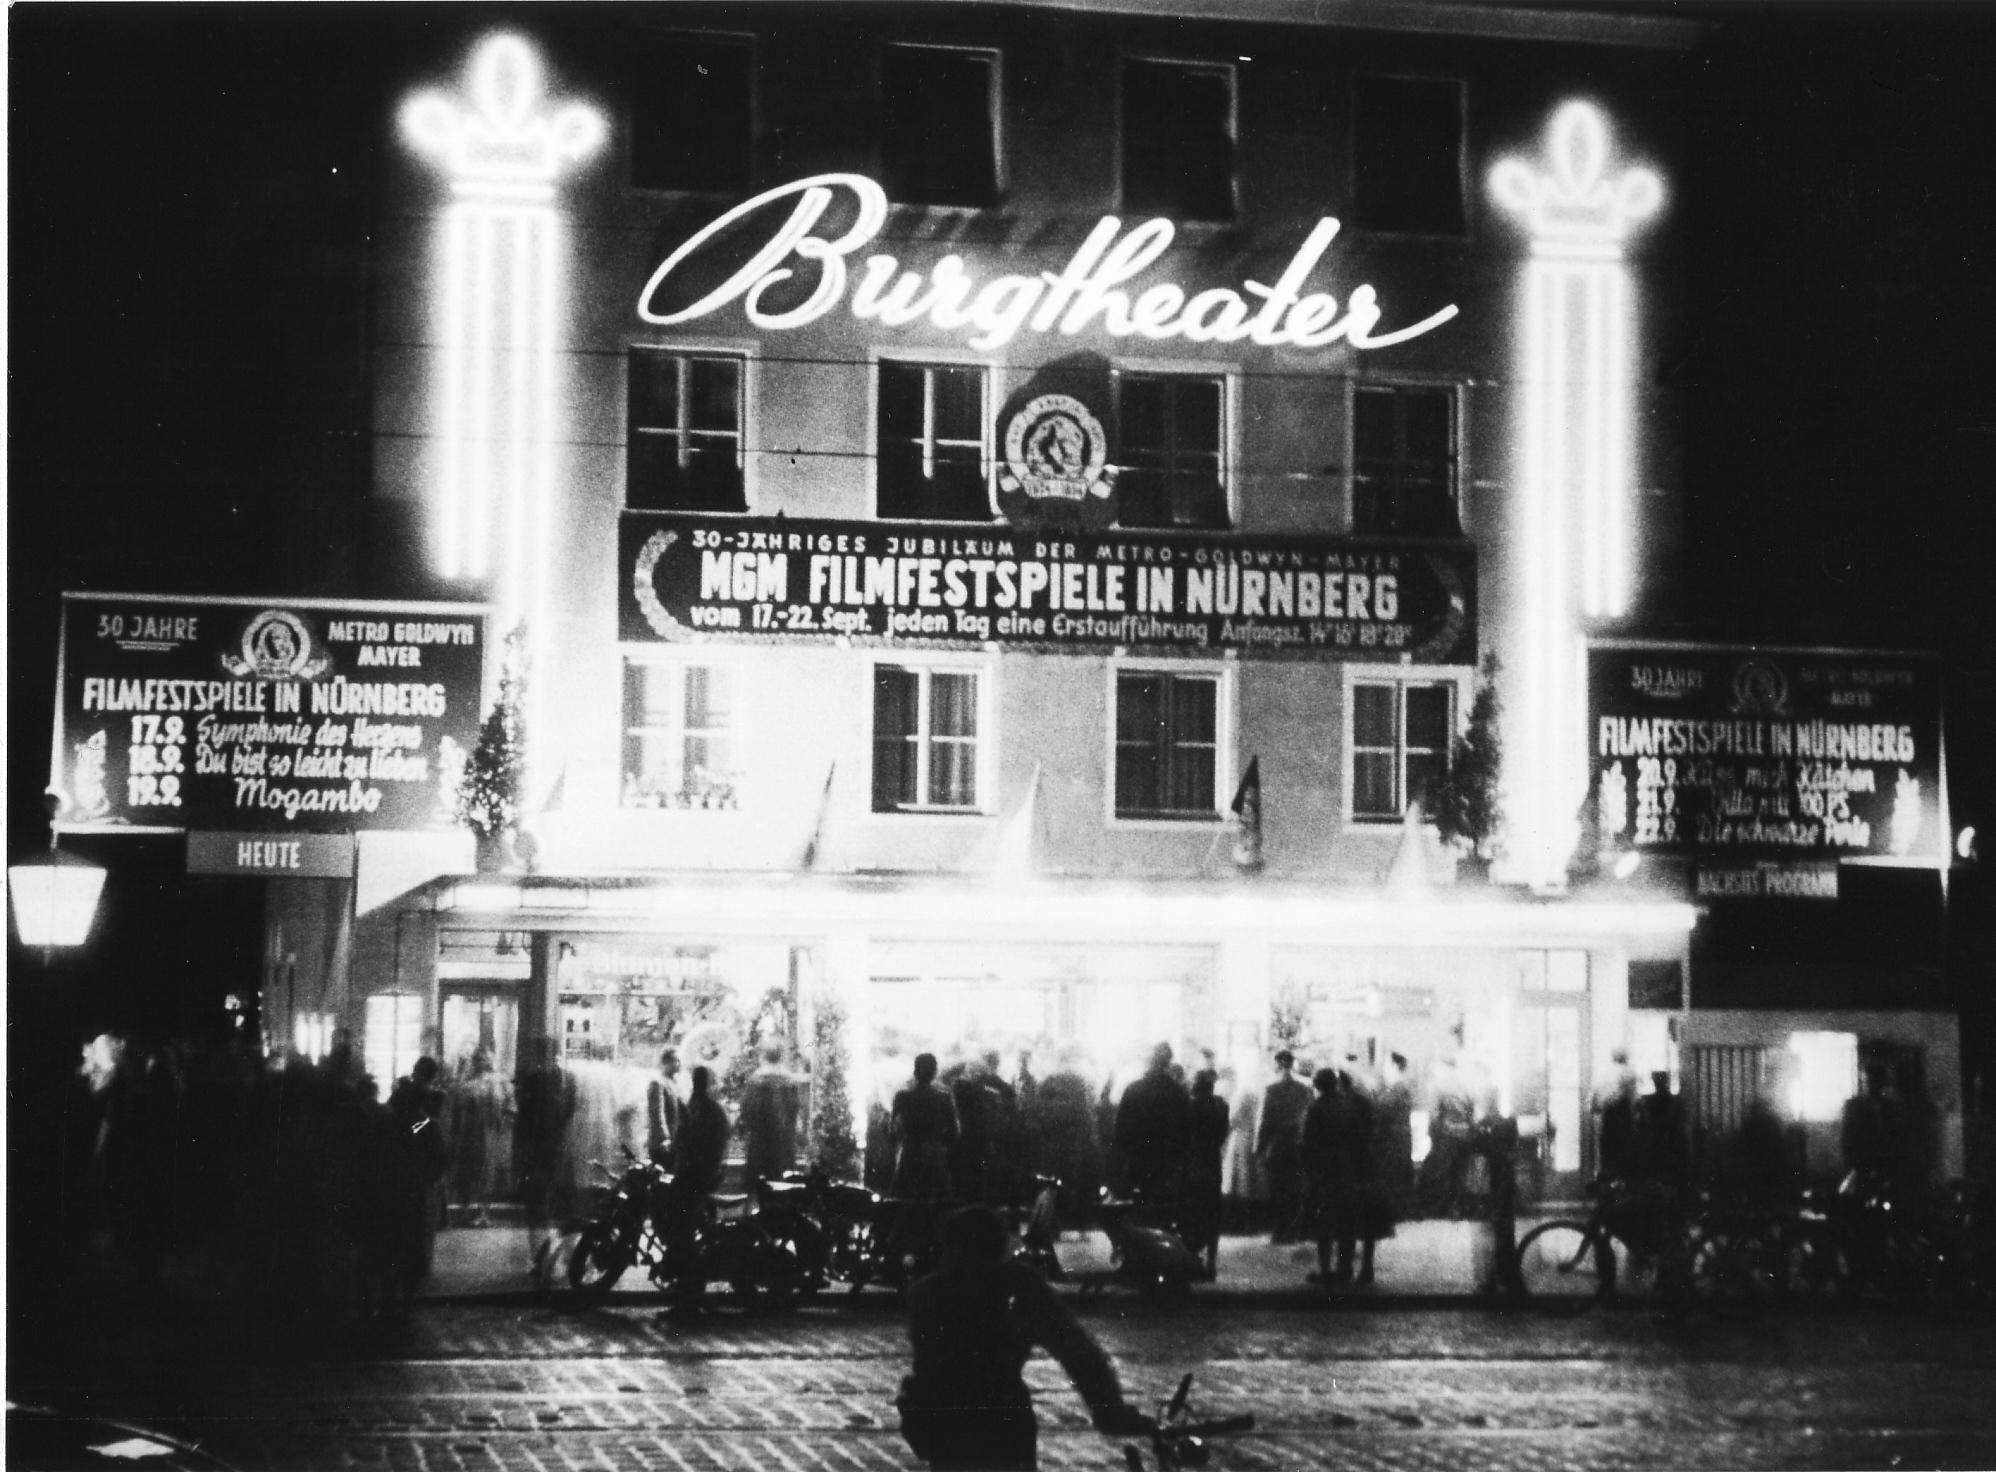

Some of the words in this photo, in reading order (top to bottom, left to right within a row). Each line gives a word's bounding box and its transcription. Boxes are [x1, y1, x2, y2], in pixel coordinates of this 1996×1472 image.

[637, 172, 1459, 350] Burgtheater
[692, 529, 866, 551] 30-JÄHRIGES
[887, 536, 1015, 557] JUBILÄUM
[1035, 541, 1076, 559] DER
[700, 549, 788, 603] MGM
[808, 554, 1126, 612] FILMFESTSPIELE
[1136, 565, 1174, 614] IN
[1186, 557, 1398, 620] NÜRNBERG
[97, 615, 122, 638] 30
[130, 616, 198, 641] JAHRE
[328, 621, 390, 642] METRO
[394, 622, 474, 645] GOLDWYN
[690, 605, 741, 628] vom
[821, 605, 872, 636] Sept.
[883, 605, 949, 638] jeden
[953, 608, 990, 639] Tag
[996, 610, 1047, 635] eine
[1052, 612, 1209, 648] Erstaufführung
[357, 645, 422, 667] MAYER
[83, 677, 267, 713] FILMFESTSPIELE
[274, 681, 300, 714] IN
[312, 674, 446, 717] NÜRNBERG
[131, 714, 187, 745] 17.9.
[197, 713, 312, 750] Symphonie
[315, 717, 347, 747] des
[1600, 715, 1763, 756] FILMFESTSPIELE
[1770, 720, 1793, 756] IN
[1797, 718, 1915, 763] NÜRNBERG
[128, 744, 185, 774] 18.9.
[195, 742, 227, 774] Du
[231, 745, 267, 775] bist
[268, 754, 291, 777] so
[294, 747, 342, 778] leicht
[127, 774, 182, 807] 19.9.
[233, 777, 382, 820] Mogambo
[237, 841, 301, 868] HEUTE
